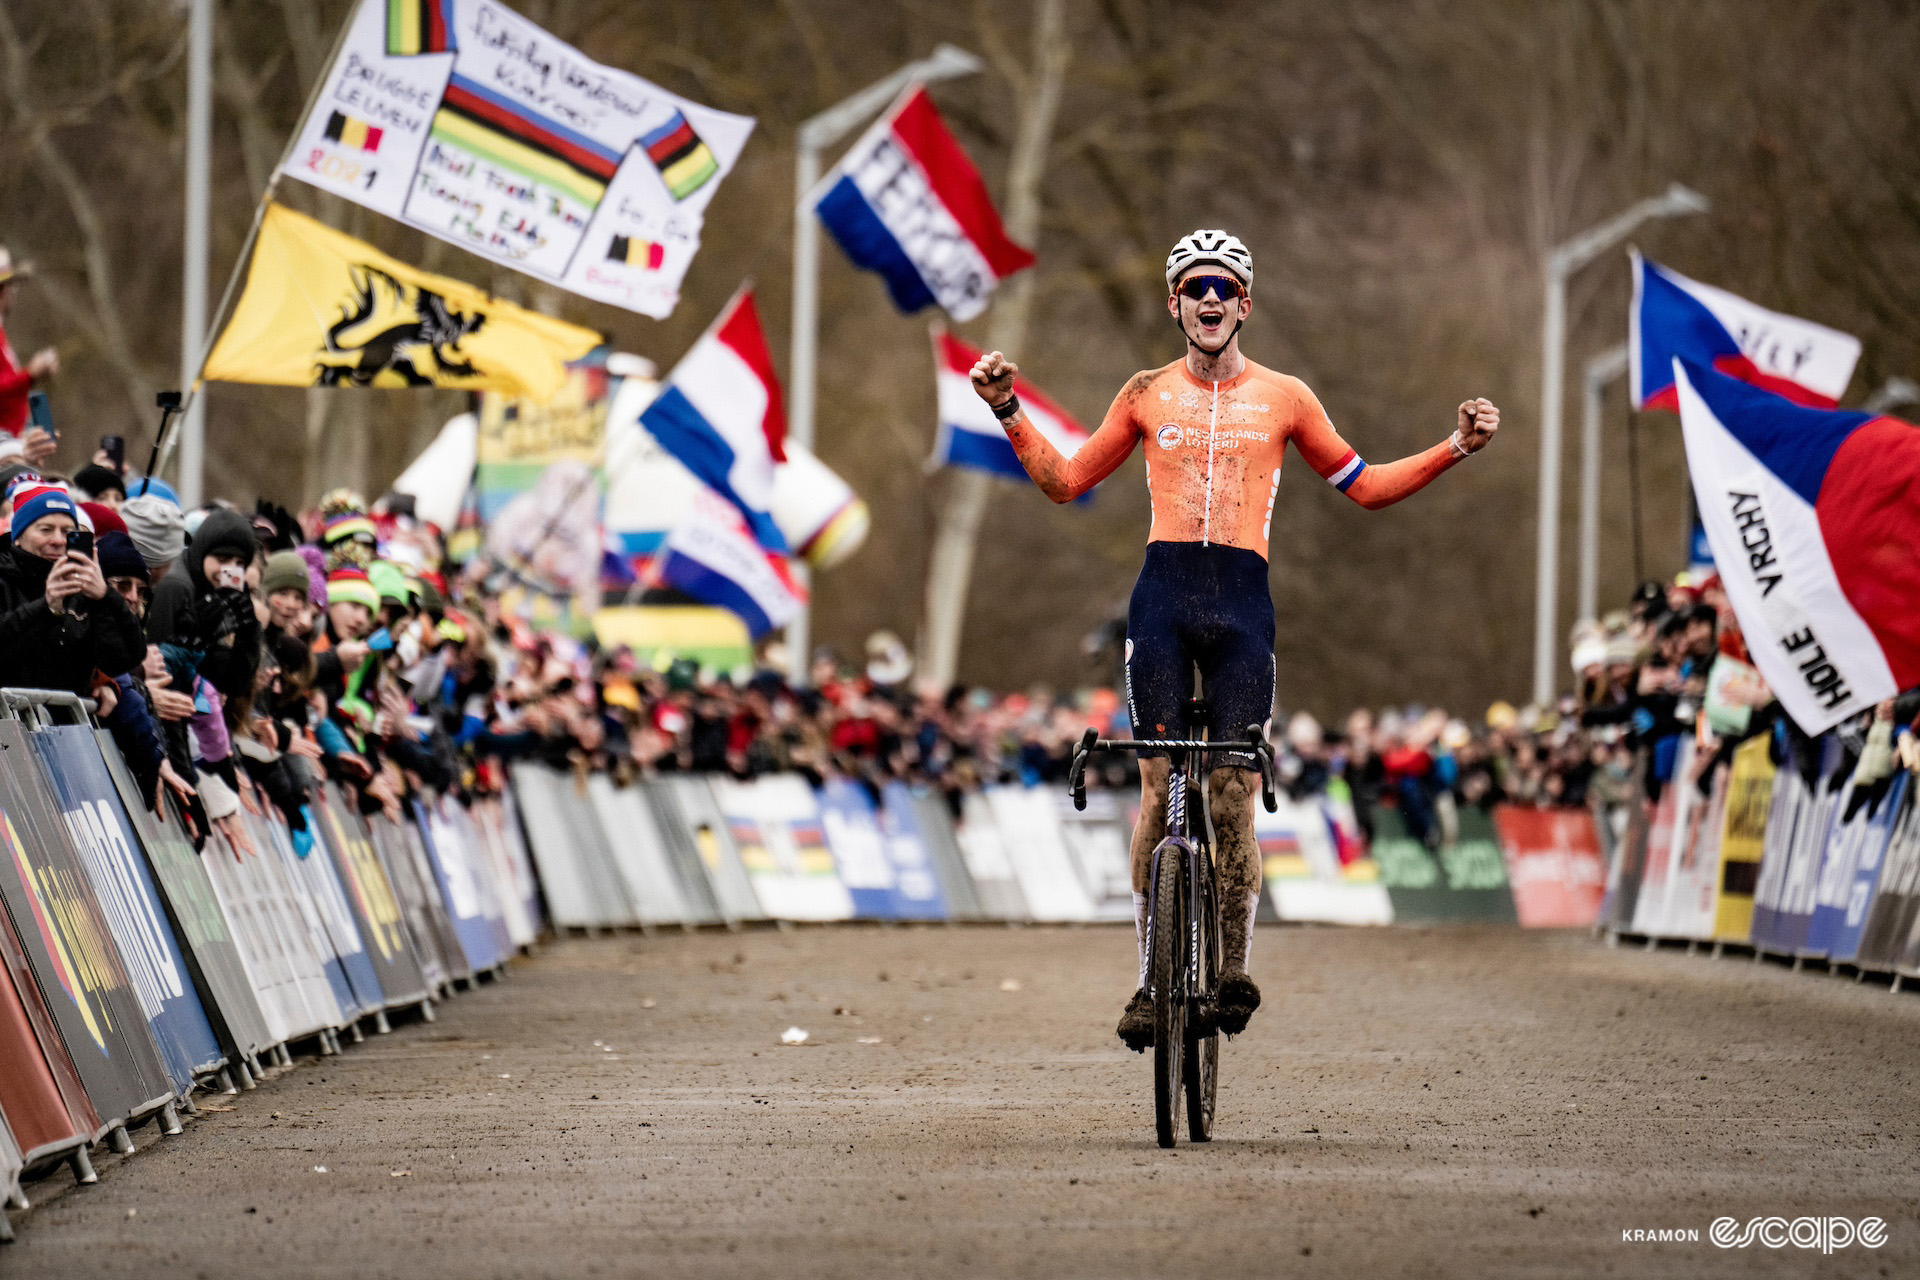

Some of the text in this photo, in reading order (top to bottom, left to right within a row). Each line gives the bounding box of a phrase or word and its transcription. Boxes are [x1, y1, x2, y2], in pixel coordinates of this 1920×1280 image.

[307, 147, 378, 190] 2021
[1186, 427, 1270, 443] NEDERLANDSE
[1186, 437, 1239, 450] LOTERIJ
[1727, 491, 1784, 598] VRCHY
[1167, 772, 1177, 827] CANYON
[1175, 774, 1186, 826] CANYON
